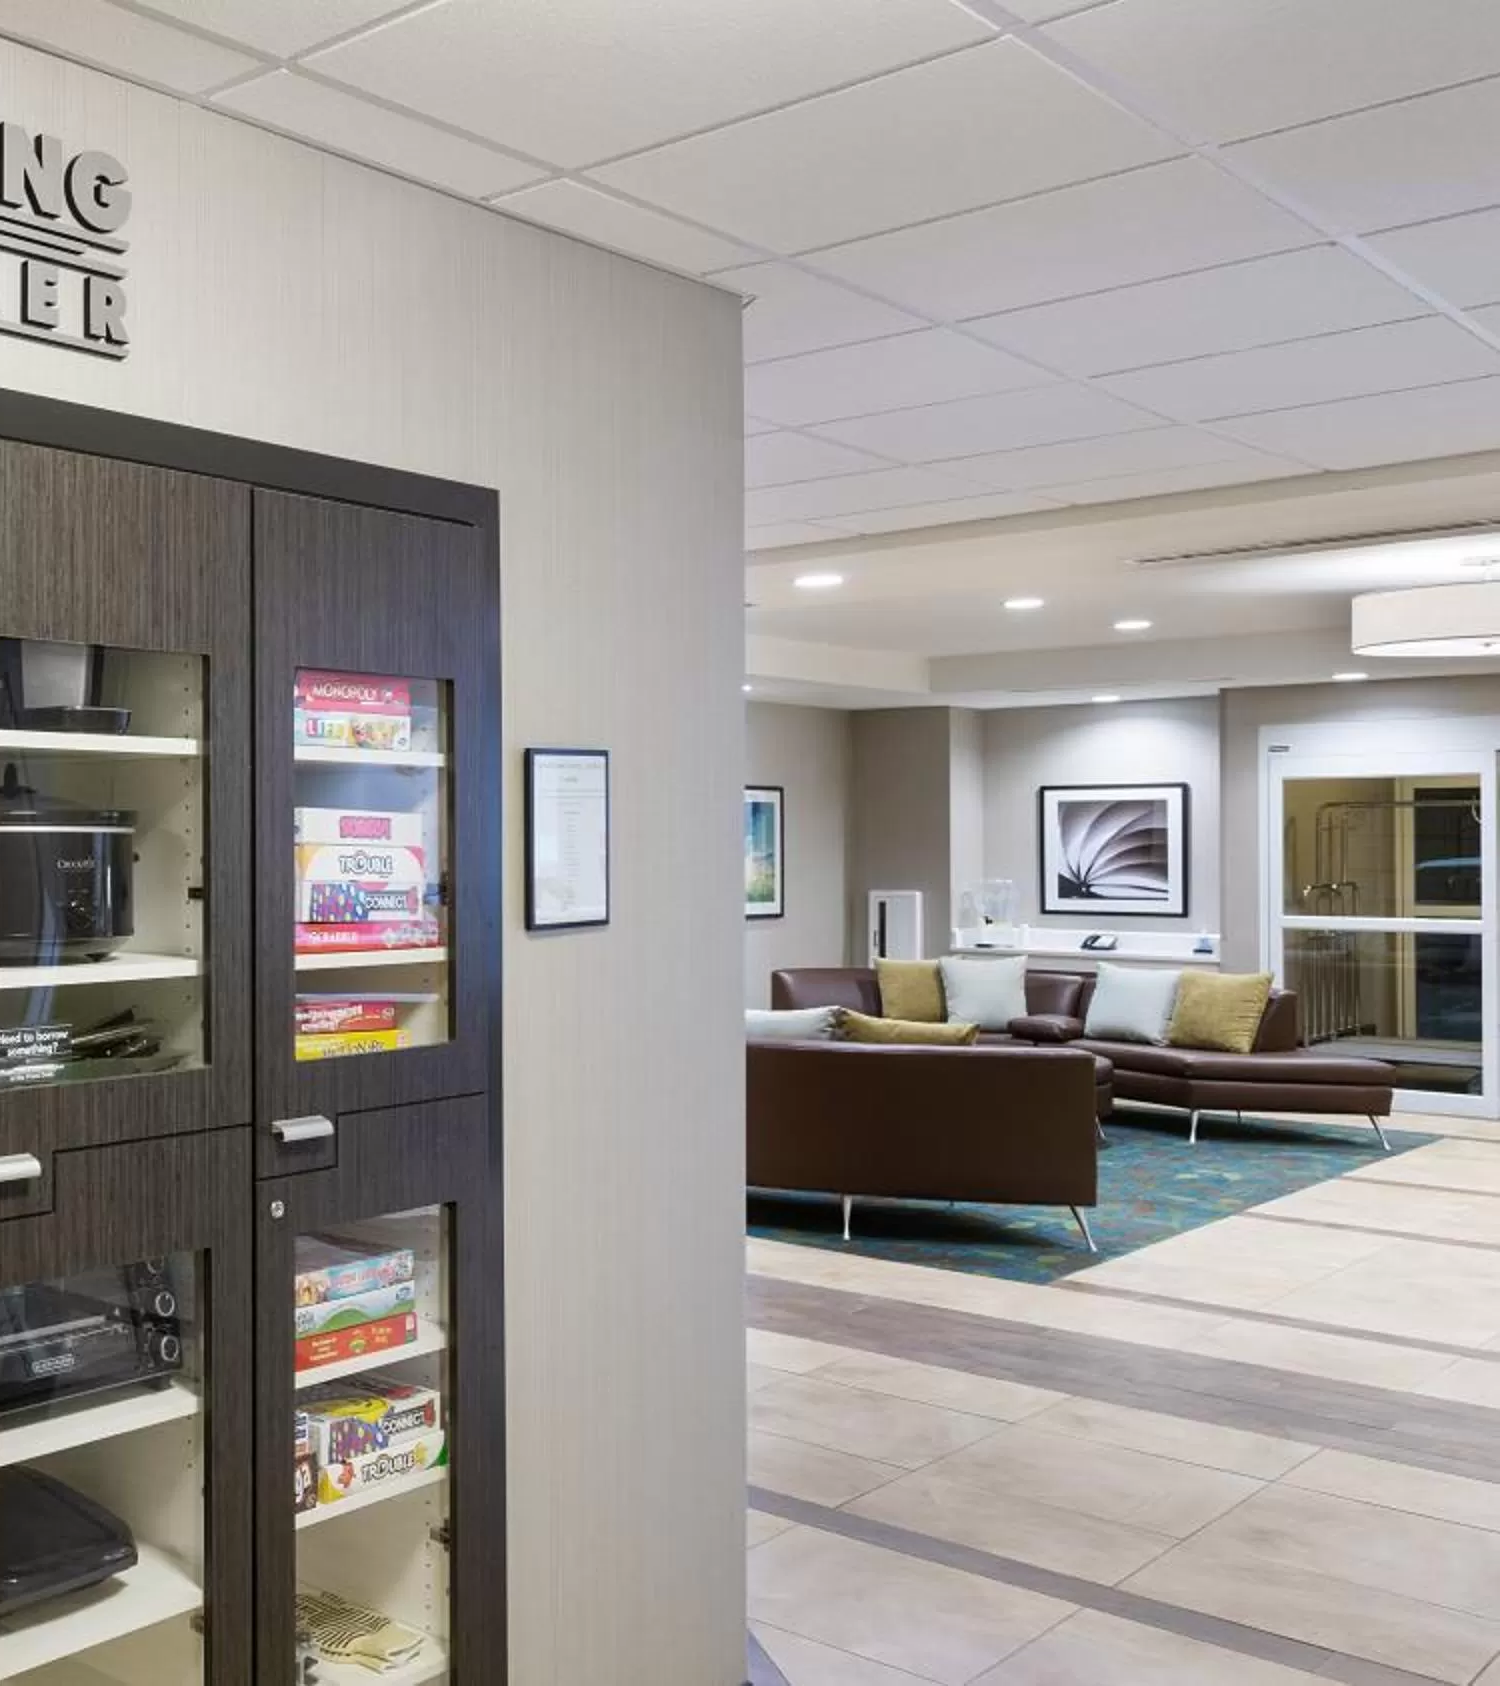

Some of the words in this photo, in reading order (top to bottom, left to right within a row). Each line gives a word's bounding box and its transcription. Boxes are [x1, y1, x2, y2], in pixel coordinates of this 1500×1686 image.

[339, 850, 393, 875] TROUBLE
[23, 1033, 35, 1043] to
[381, 1411, 424, 1435] CONNECT
[361, 1453, 416, 1483] TROUBLE
